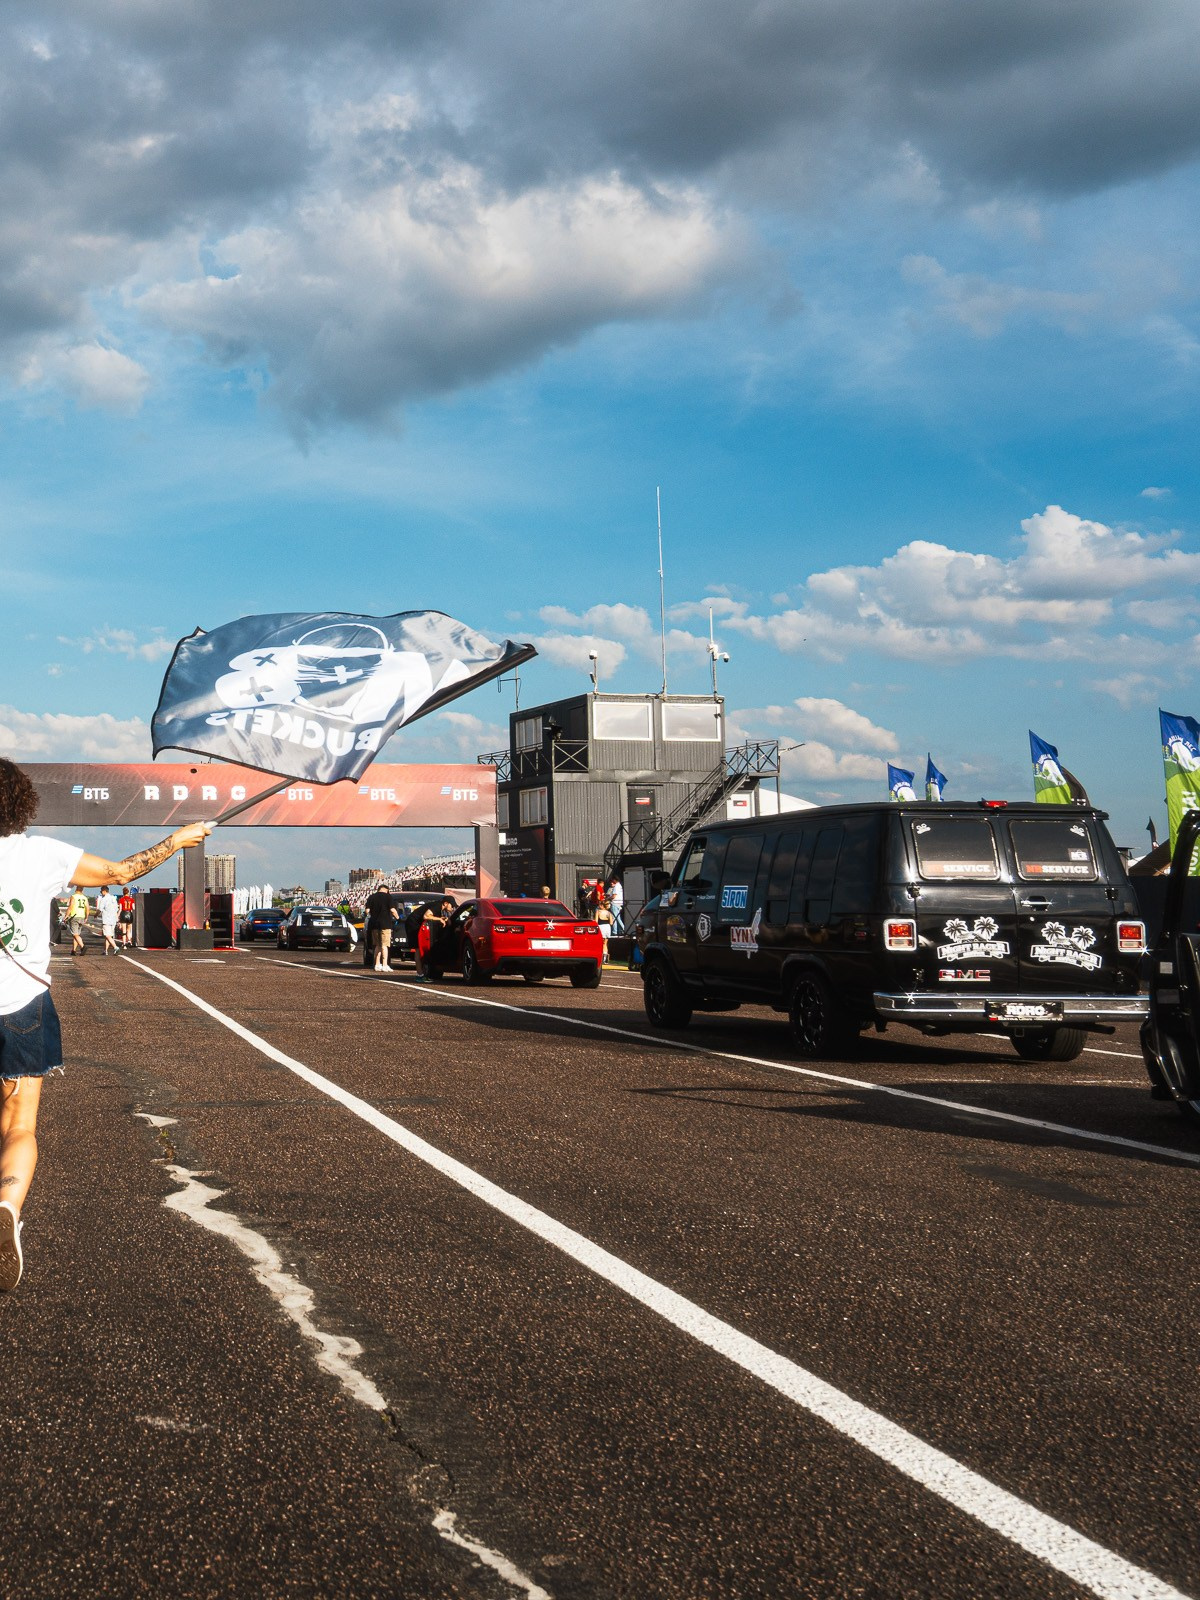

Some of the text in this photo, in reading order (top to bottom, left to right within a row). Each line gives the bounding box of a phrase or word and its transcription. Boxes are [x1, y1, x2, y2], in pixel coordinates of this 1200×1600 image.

[83, 787, 110, 800] ВТБ
[144, 785, 247, 801] RDRC
[287, 788, 314, 801] ВТБ
[370, 788, 396, 801] ВТБ
[452, 789, 479, 801] ВТБ
[938, 969, 991, 980] GMC
